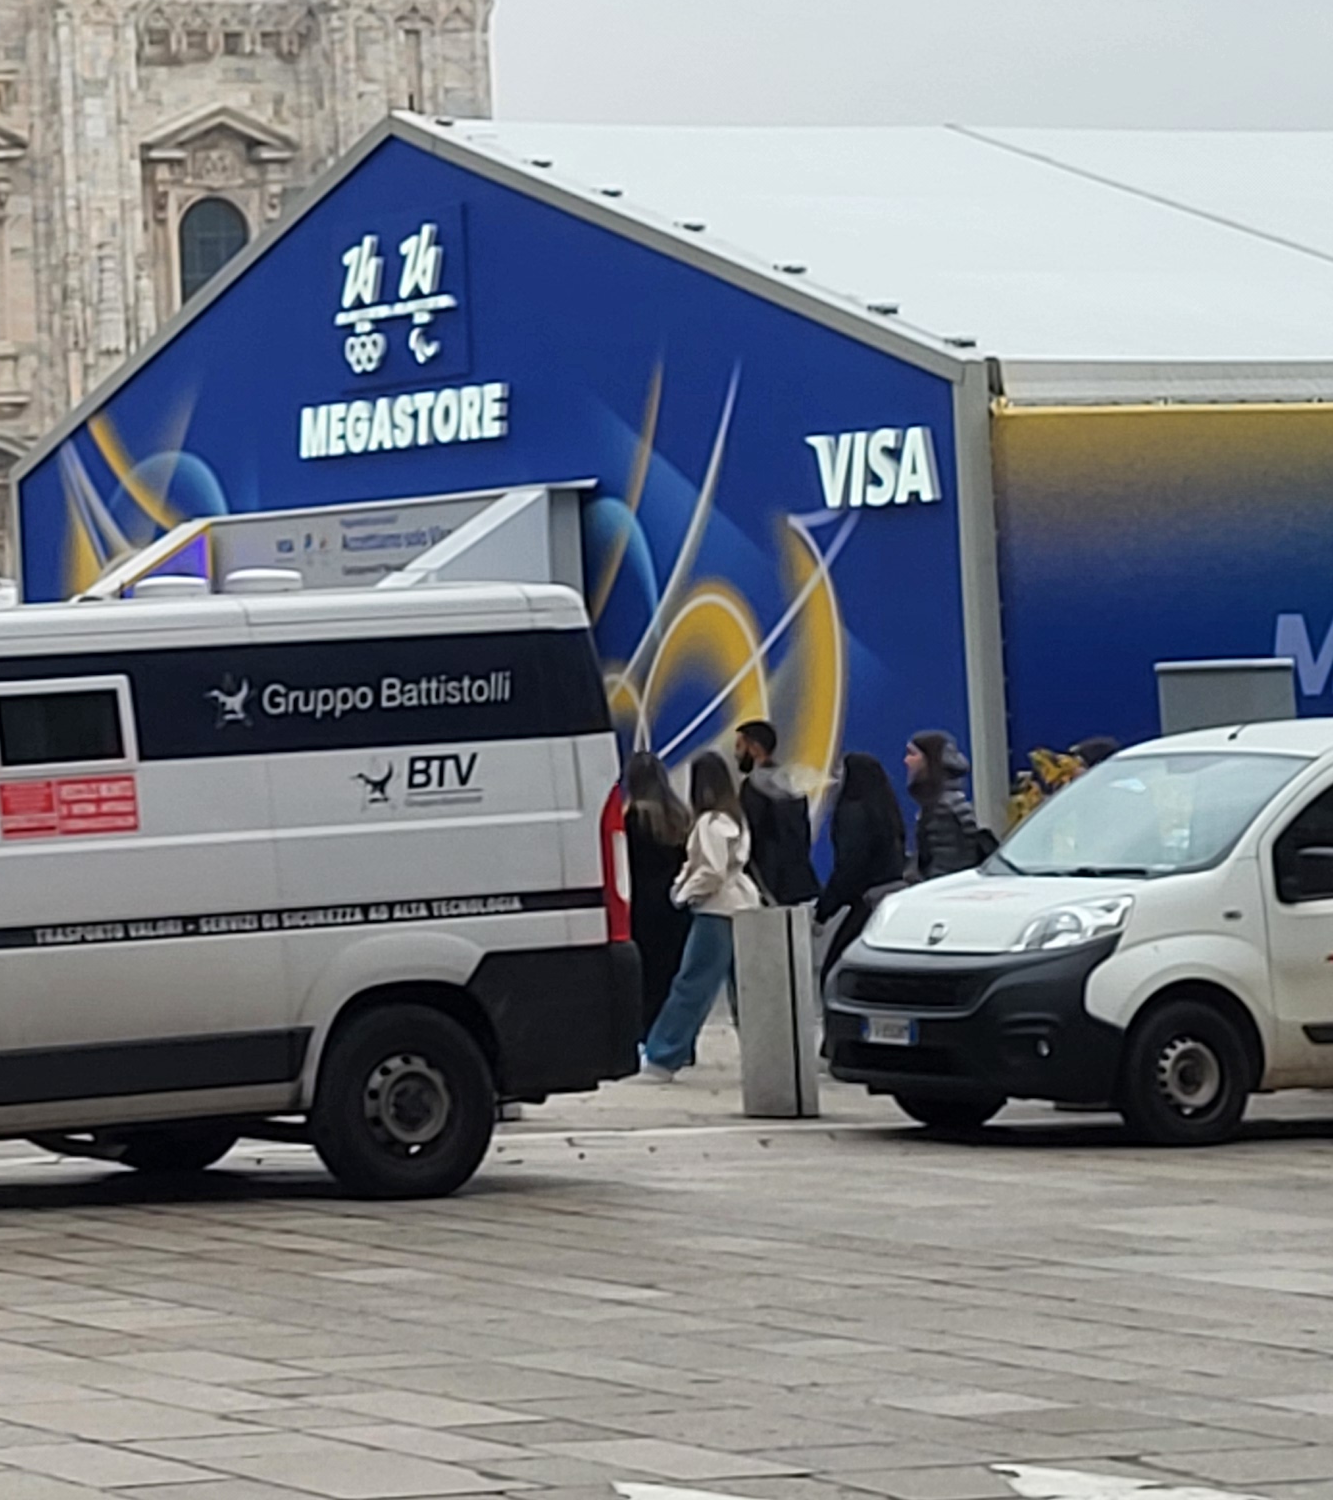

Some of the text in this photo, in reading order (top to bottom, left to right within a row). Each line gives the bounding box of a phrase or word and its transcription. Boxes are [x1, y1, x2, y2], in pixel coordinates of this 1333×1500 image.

[300, 382, 509, 459] MEGASTORE
[804, 426, 942, 508] VISA
[261, 670, 512, 719] Gruppo Battistolli
[407, 752, 479, 790] BTV
[34, 923, 125, 945] TRASPORTO
[128, 918, 183, 938] VALORI
[199, 914, 259, 933] SERVIZI
[261, 912, 279, 930] DI
[282, 905, 364, 928] SICUREZZA
[368, 903, 390, 921] AD
[393, 901, 429, 919] ALTA
[432, 896, 523, 917] TECNOLOGIA
